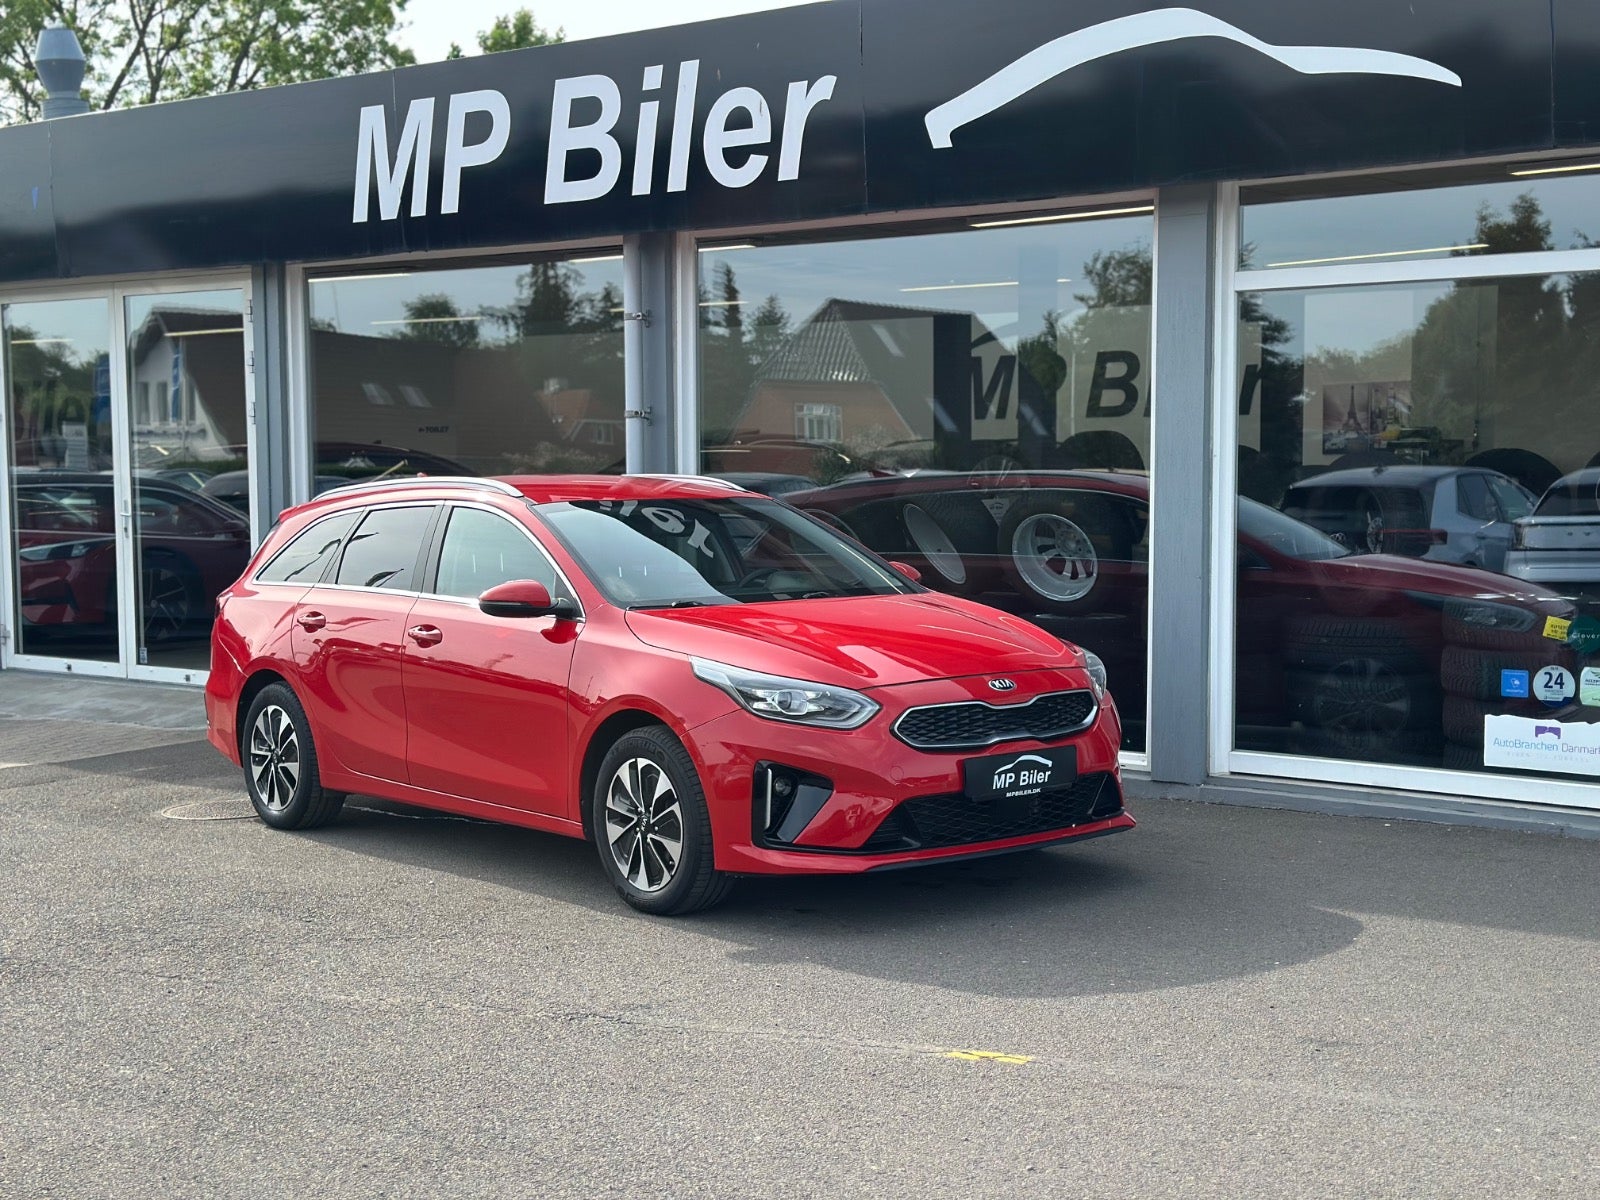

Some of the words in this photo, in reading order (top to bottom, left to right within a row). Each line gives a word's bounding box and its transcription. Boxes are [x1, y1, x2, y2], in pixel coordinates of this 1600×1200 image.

[353, 89, 511, 223] MP
[544, 59, 837, 205] Biler
[990, 679, 1015, 689] KIA
[1543, 671, 1565, 690] 24
[1493, 737, 1559, 751] AutoBranchen
[992, 772, 1016, 790] MP
[1019, 769, 1052, 786] Biler
[1005, 787, 1041, 798] MPBILER.DK
